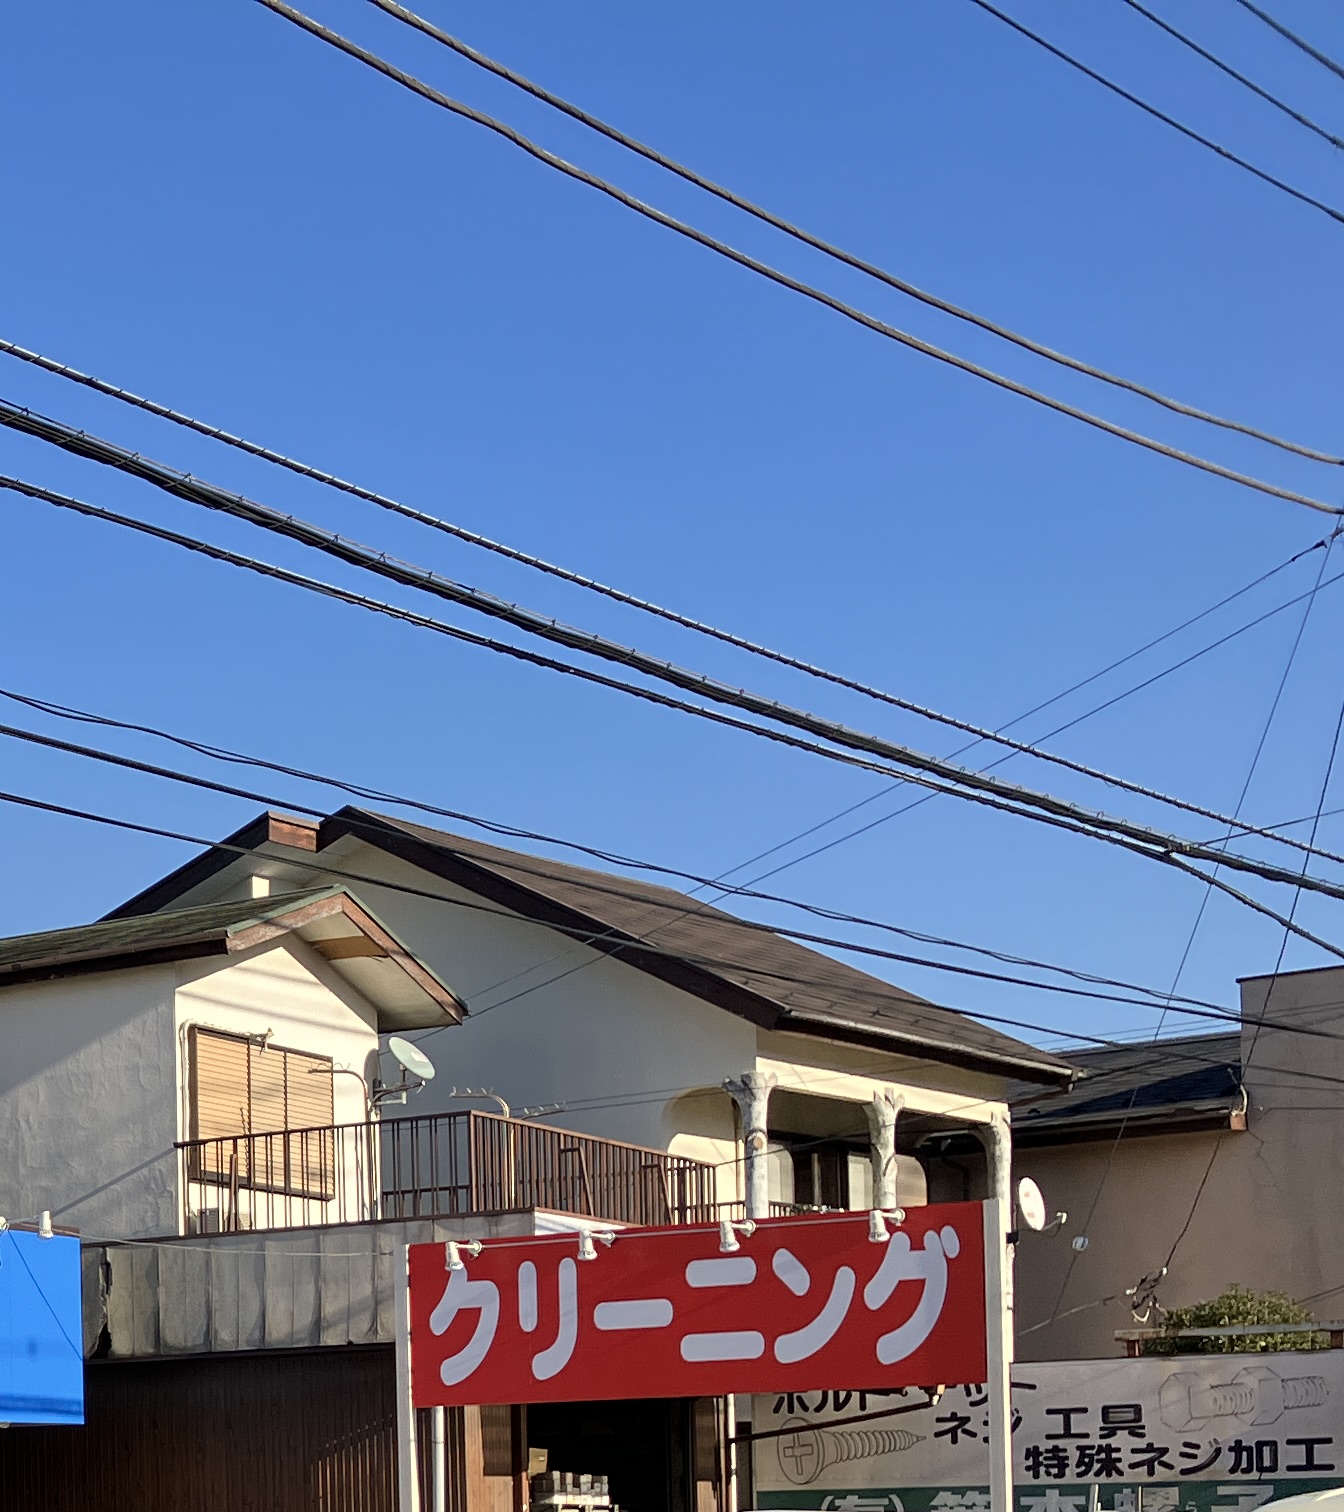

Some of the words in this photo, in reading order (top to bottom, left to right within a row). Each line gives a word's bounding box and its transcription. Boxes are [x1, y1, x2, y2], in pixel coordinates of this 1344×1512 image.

[428, 1225, 960, 1387] クリーニング
[1044, 1404, 1146, 1440] 工具
[1023, 1437, 1336, 1480] 特殊ネジ加工
